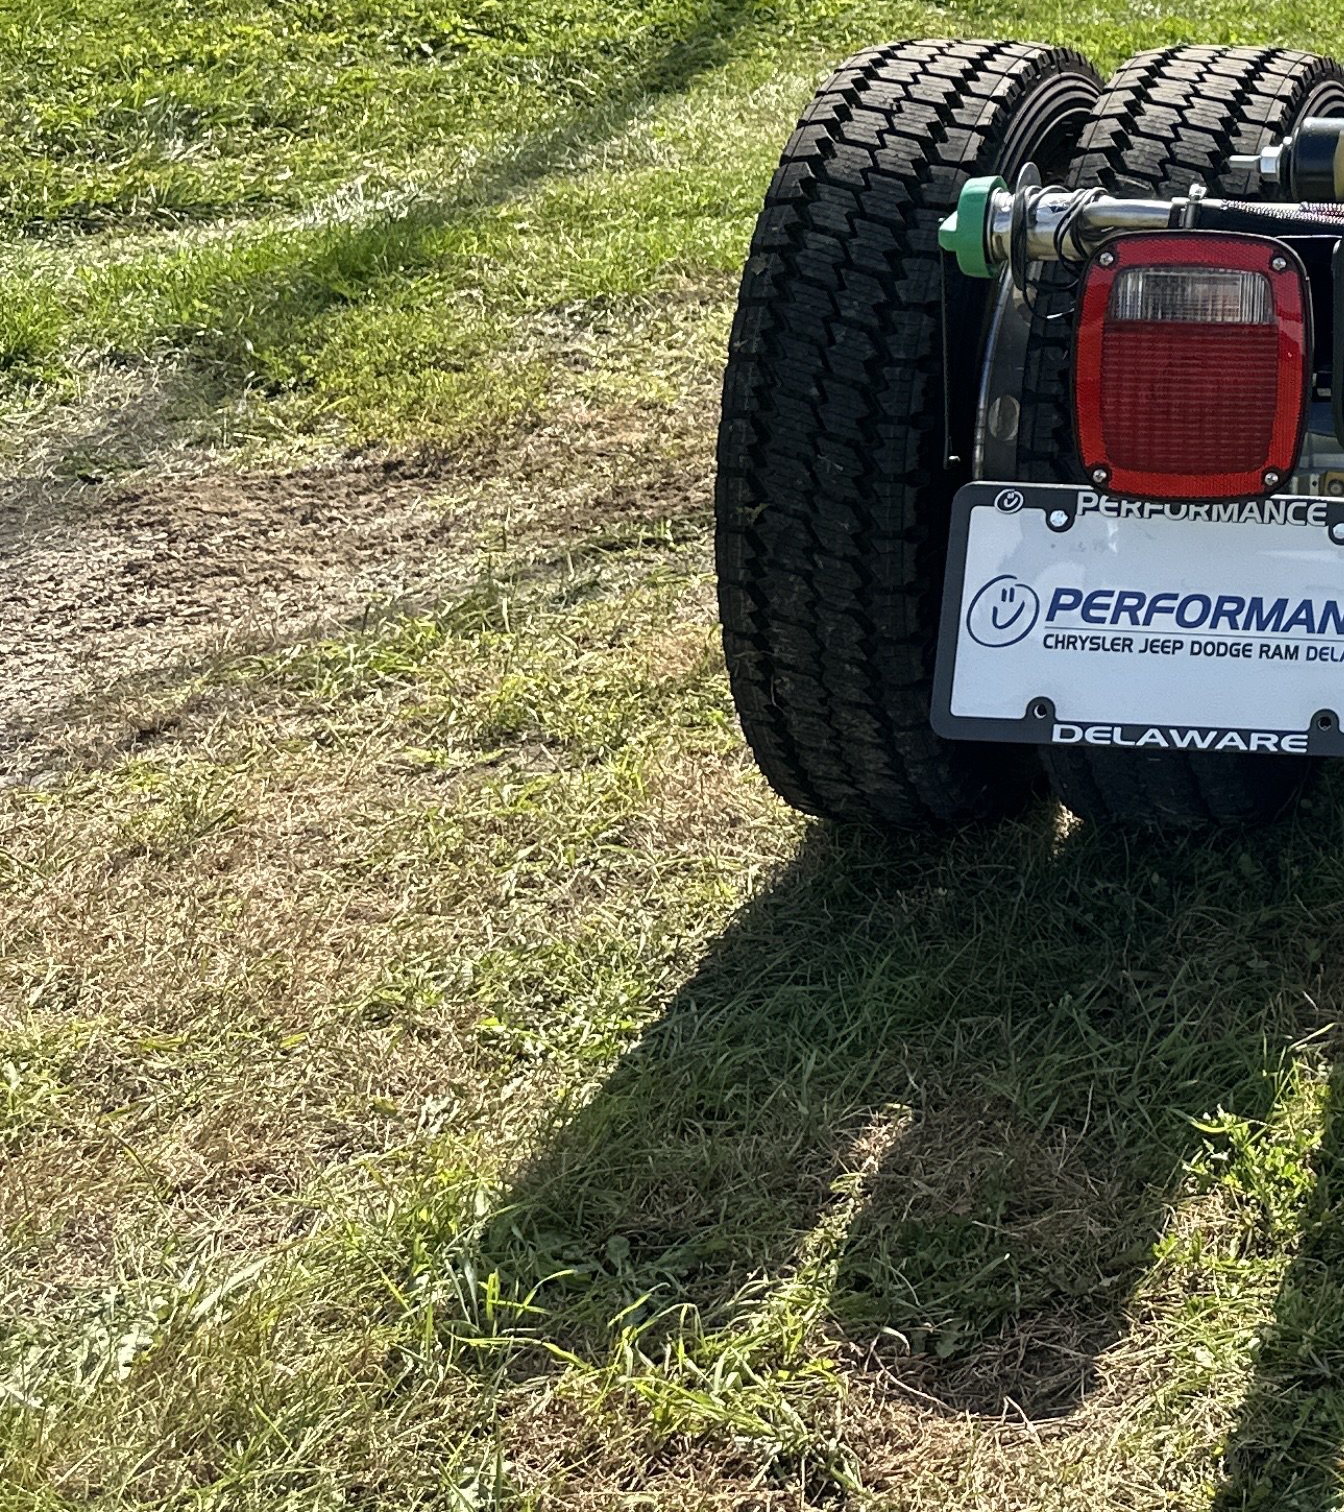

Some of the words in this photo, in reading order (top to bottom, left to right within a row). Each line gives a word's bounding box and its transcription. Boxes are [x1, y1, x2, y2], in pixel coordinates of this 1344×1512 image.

[1076, 491, 1328, 527] PERFORMANCE
[1043, 633, 1133, 653] CHRYSLER
[1139, 638, 1184, 655] JEEP
[1190, 640, 1253, 659] DODGE
[1259, 643, 1299, 661] RAM
[1051, 724, 1309, 754] DELAWARE
